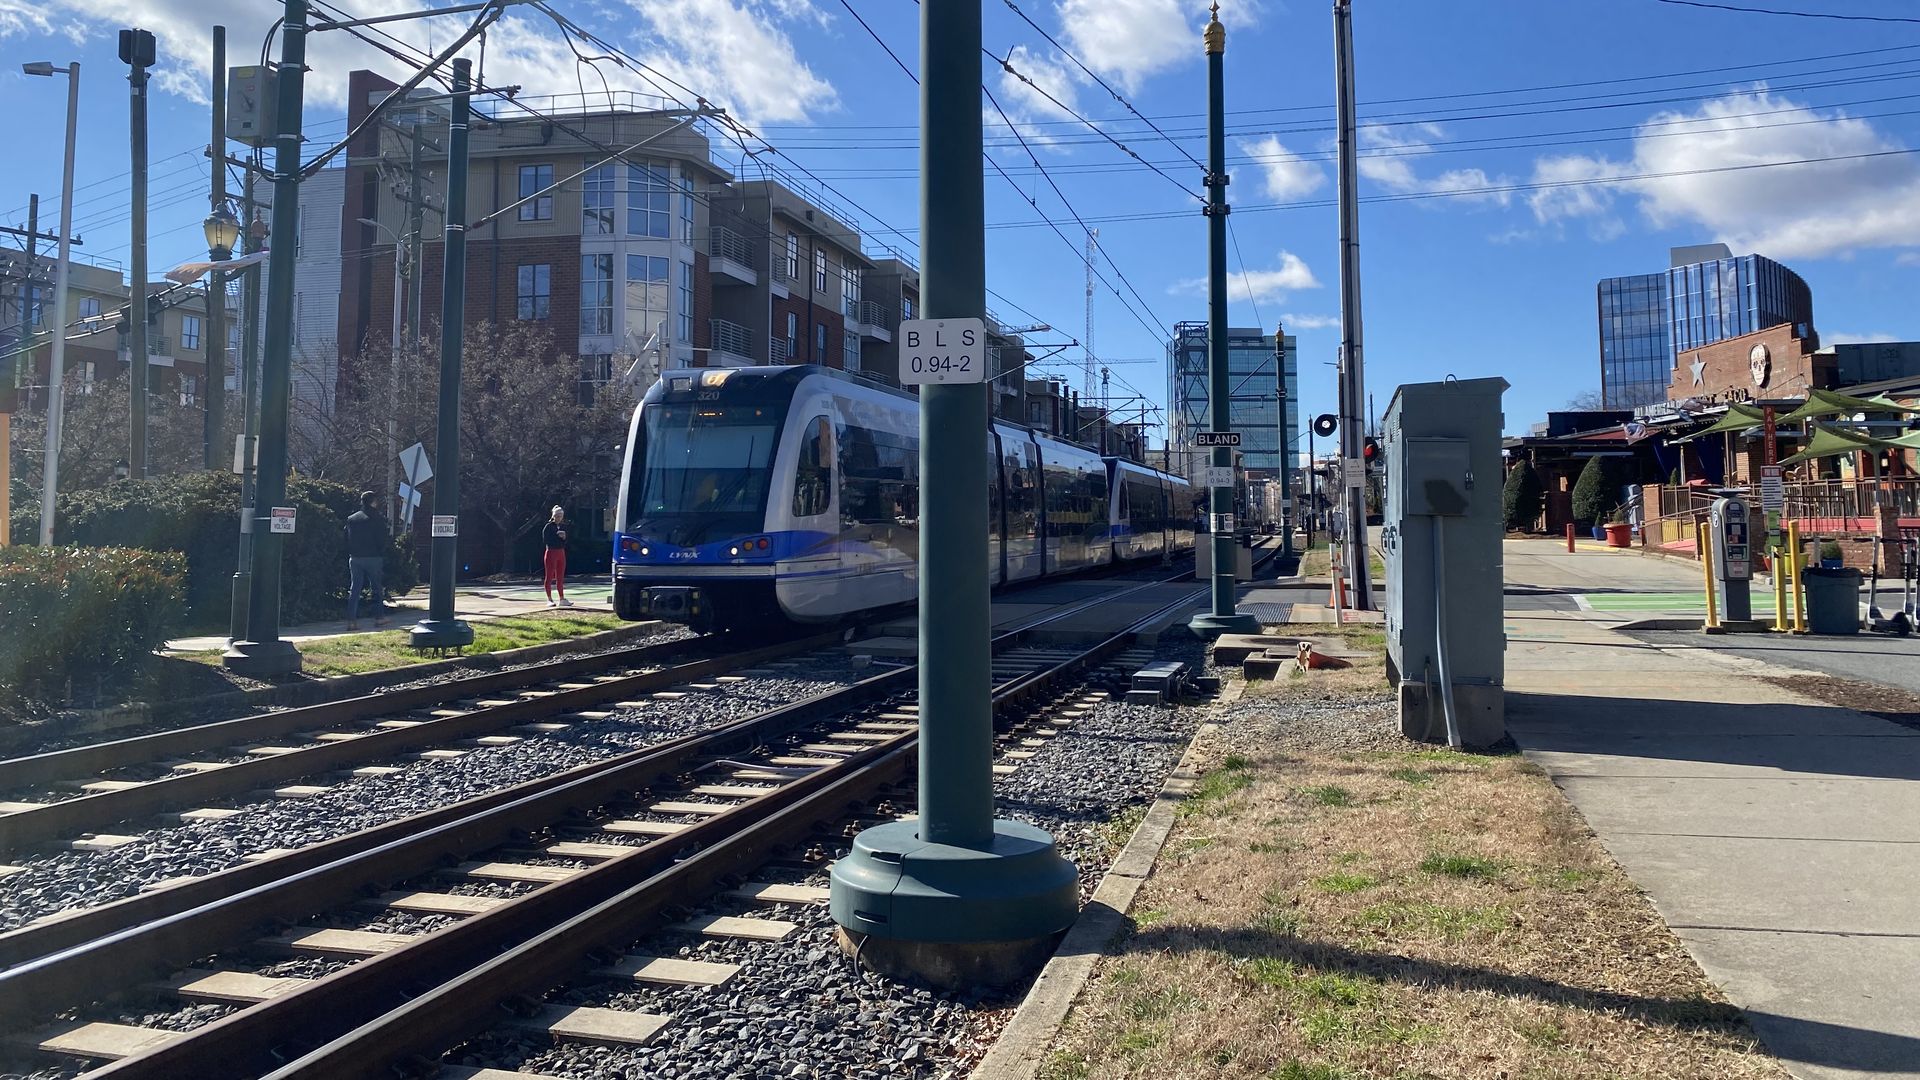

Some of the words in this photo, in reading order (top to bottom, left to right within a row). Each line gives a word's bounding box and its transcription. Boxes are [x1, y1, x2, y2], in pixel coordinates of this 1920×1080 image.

[908, 331, 920, 347] B
[936, 331, 947, 347] L
[962, 329, 975, 346] S
[911, 355, 971, 373] 0.94-2
[698, 391, 720, 401] 320
[1198, 434, 1240, 445] BLAND
